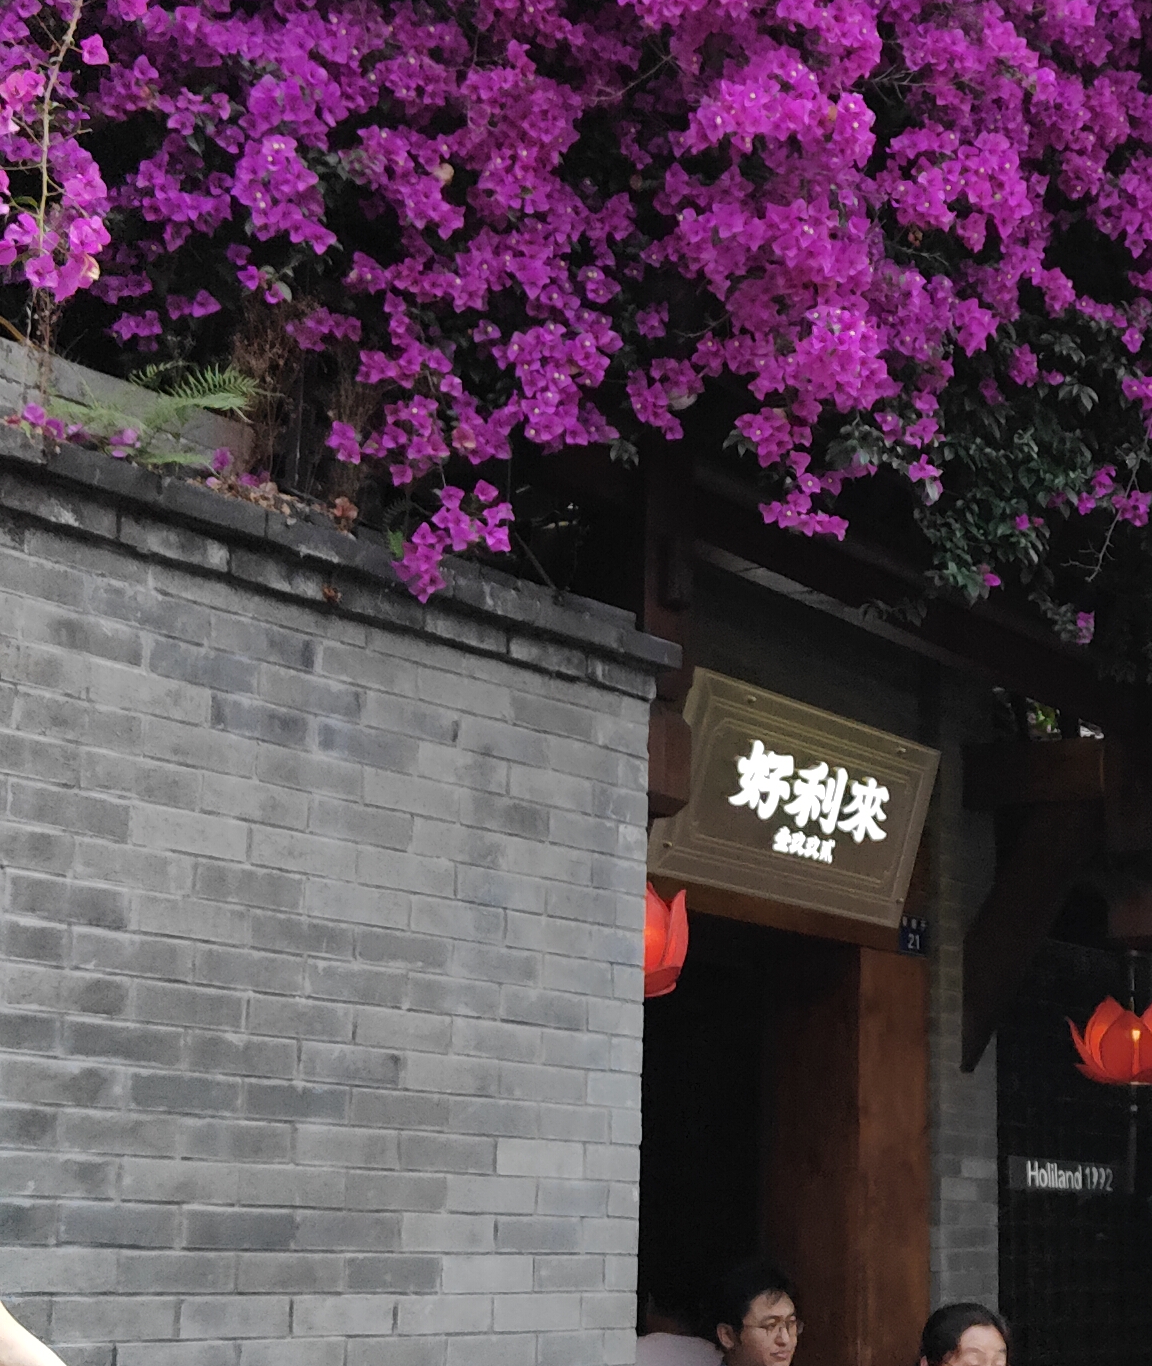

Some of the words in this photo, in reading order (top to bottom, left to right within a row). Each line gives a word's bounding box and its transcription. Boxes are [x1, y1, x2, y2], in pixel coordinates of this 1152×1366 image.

[728, 739, 891, 843] 好利來
[907, 933, 920, 950] 21
[1026, 1160, 1083, 1190] Holiland
[1085, 1166, 1114, 1192] 1992
